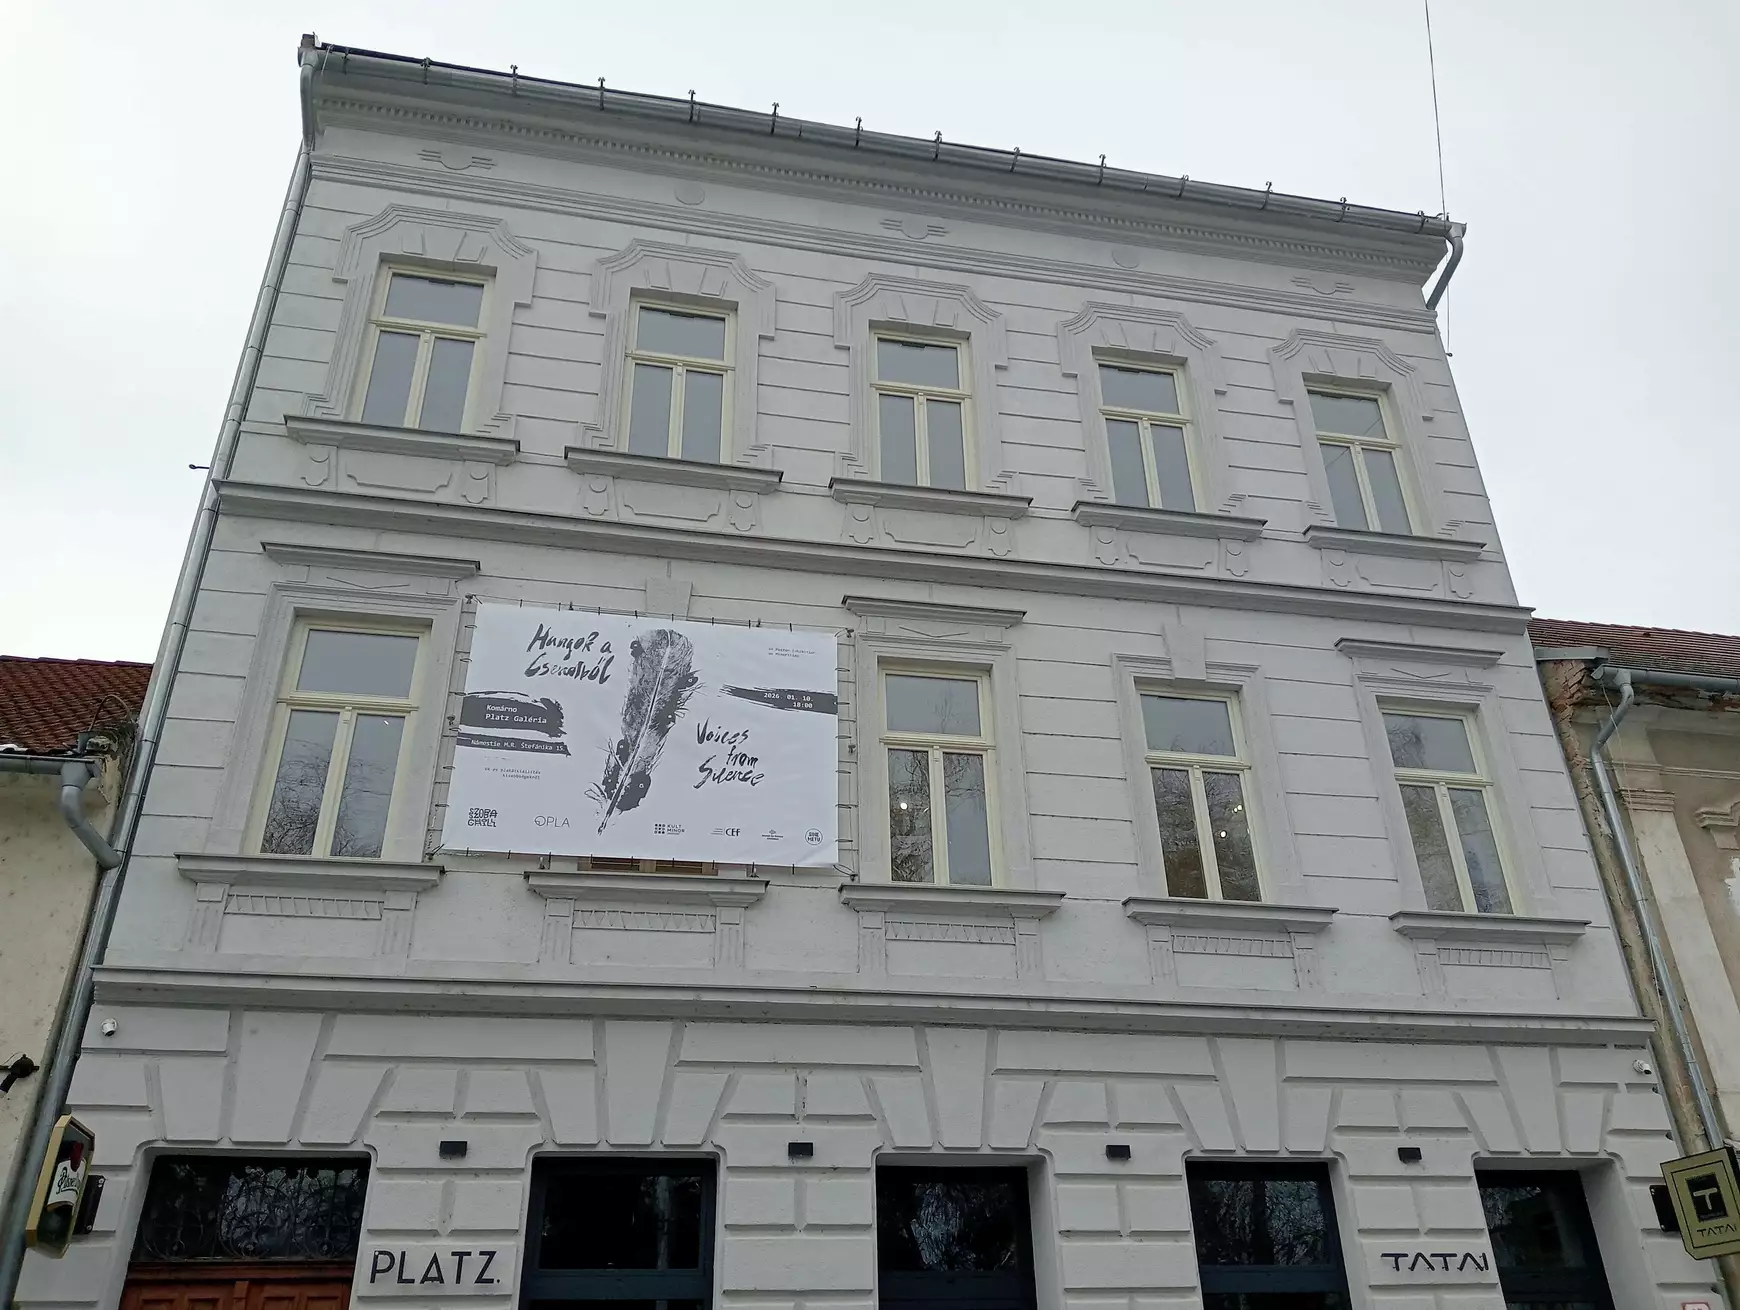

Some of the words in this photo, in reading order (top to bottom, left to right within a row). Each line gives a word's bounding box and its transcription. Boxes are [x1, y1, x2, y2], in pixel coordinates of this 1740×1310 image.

[526, 623, 599, 661] Hangok
[600, 641, 612, 654] a
[763, 692, 783, 700] 2026.
[792, 701, 813, 709] 18:00
[485, 713, 509, 721] Platz
[513, 714, 547, 724] Galéria
[486, 704, 518, 713] Komárno
[697, 717, 750, 745] Voices
[726, 745, 759, 769] from
[693, 754, 765, 789] Silence
[534, 815, 571, 828] OPLA
[1693, 1187, 1718, 1211] T
[369, 1250, 501, 1285] PLATZ.
[1380, 1252, 1489, 1272] TATAI
